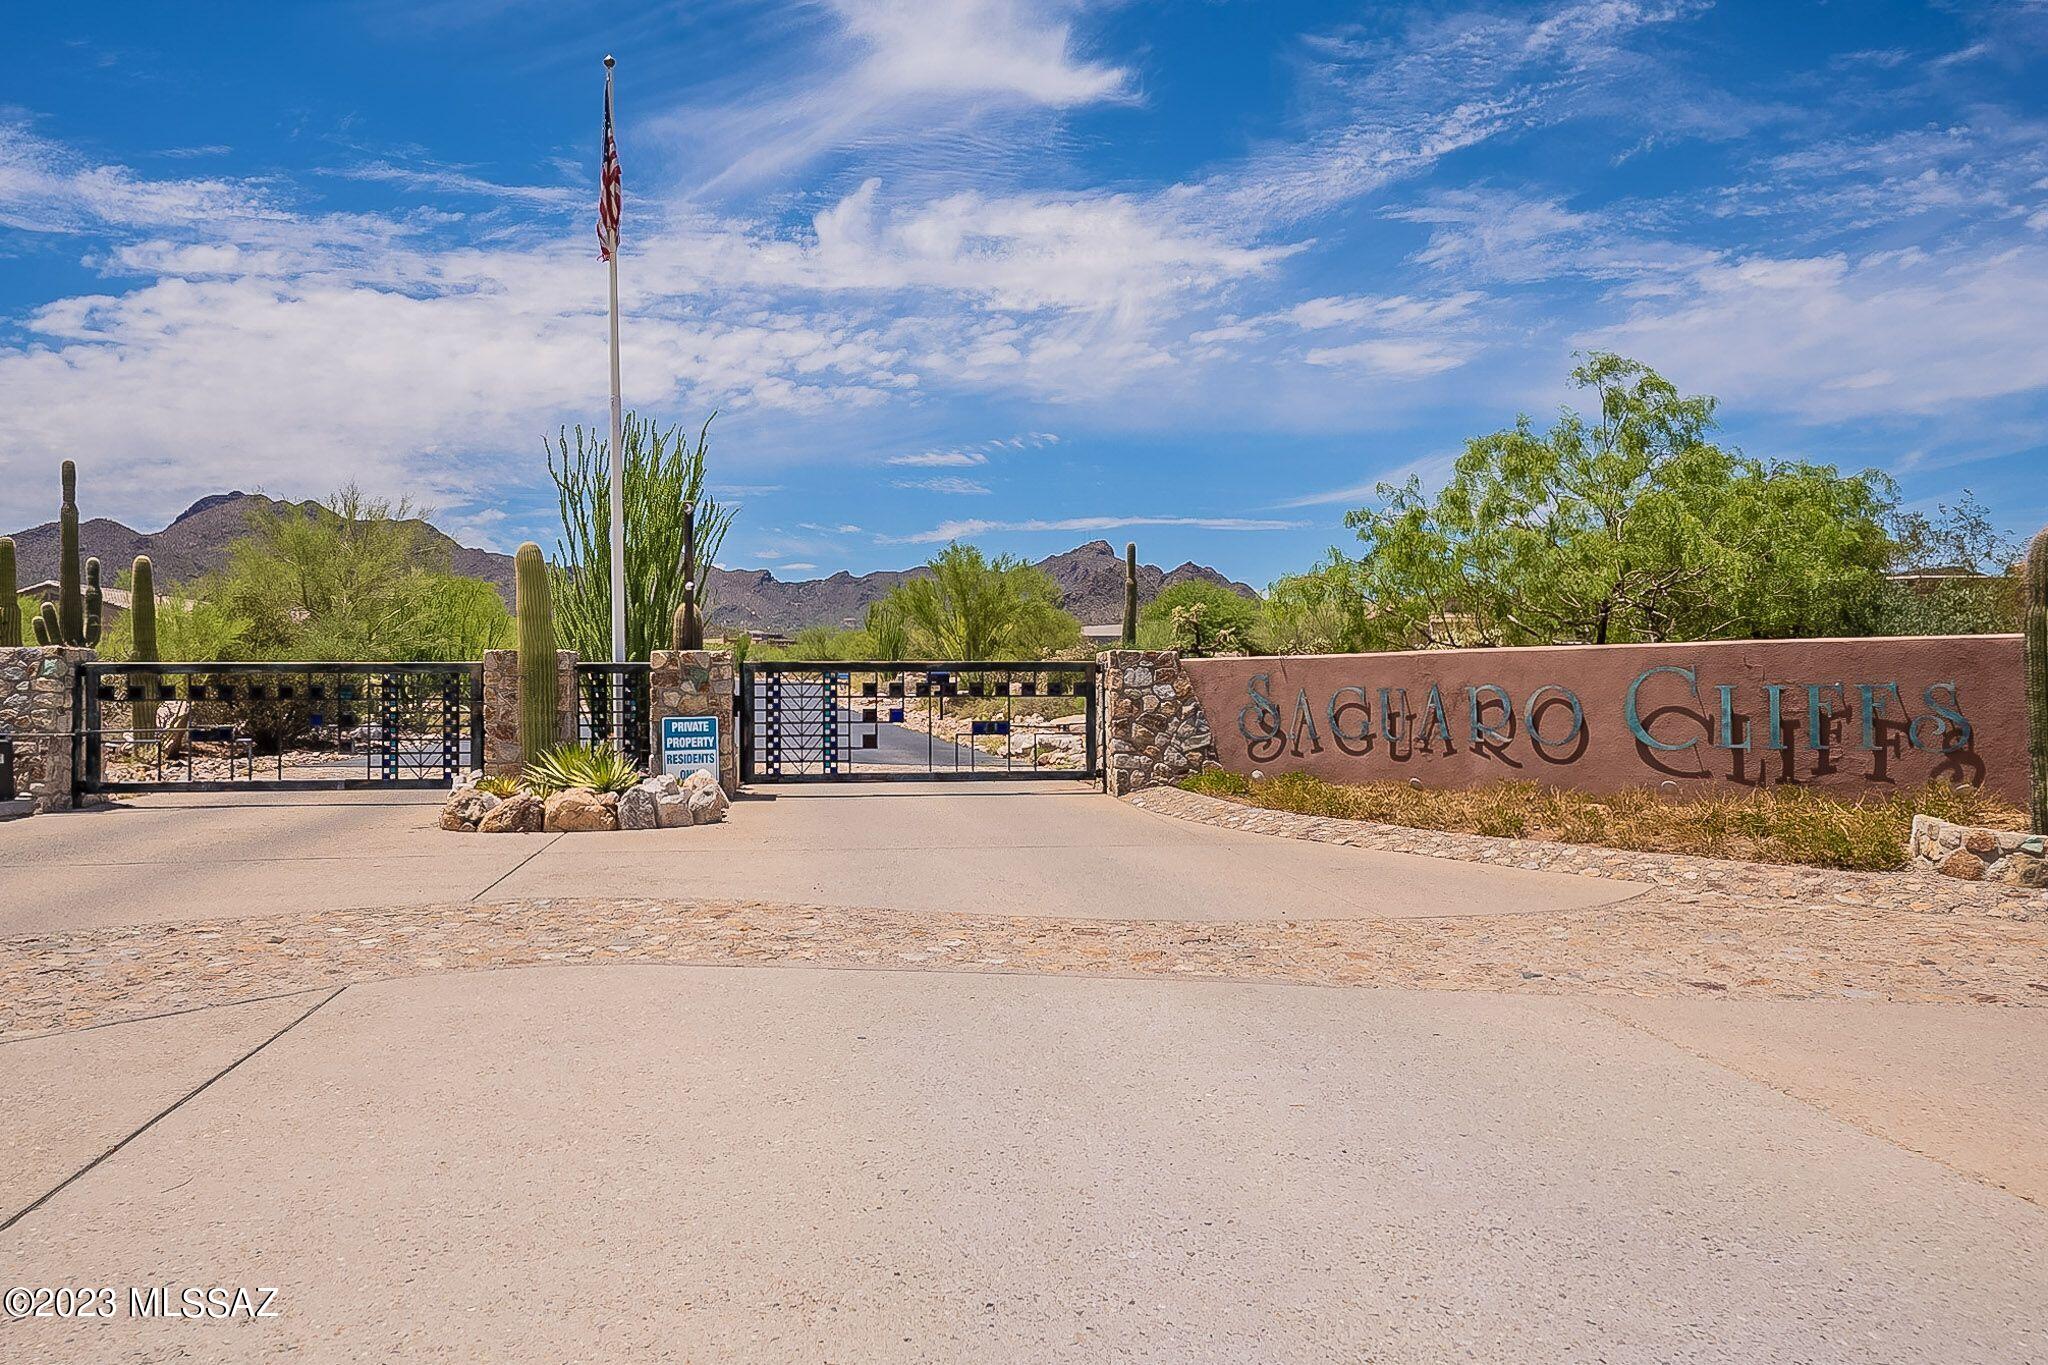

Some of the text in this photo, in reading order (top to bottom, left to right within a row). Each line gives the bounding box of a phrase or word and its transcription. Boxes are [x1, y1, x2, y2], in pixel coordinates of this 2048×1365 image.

[1238, 665, 1972, 753] SAGUARO CLIFFS
[672, 721, 709, 732] PRIVATE
[666, 736, 714, 748] PROPERTY
[666, 753, 714, 764] RESIDENTS
